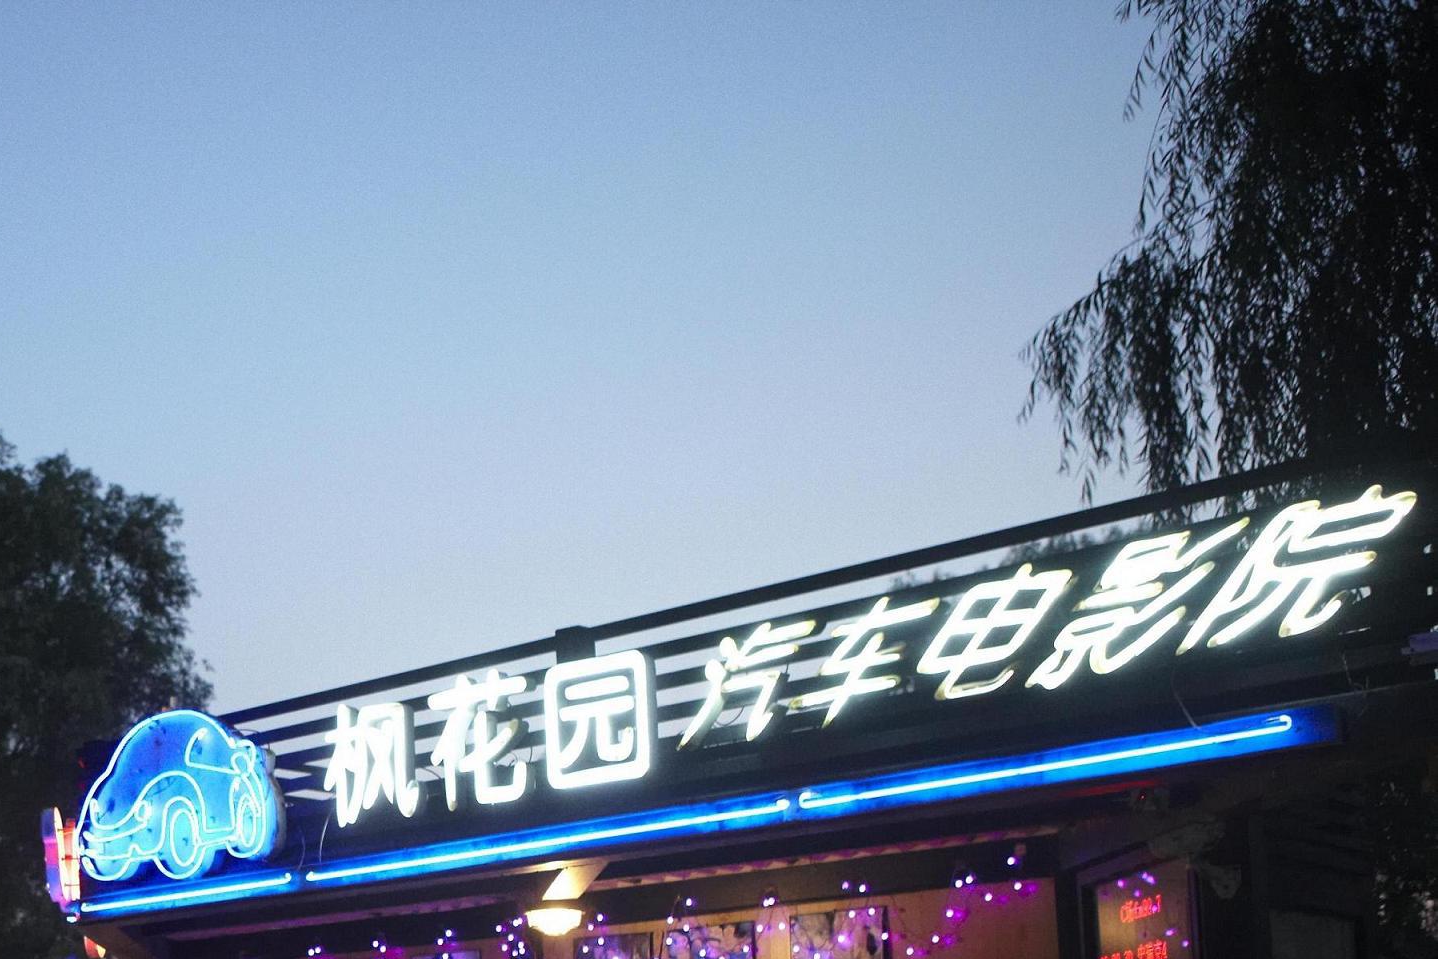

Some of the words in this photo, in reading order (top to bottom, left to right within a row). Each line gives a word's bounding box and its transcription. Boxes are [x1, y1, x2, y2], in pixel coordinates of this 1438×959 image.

[324, 650, 650, 828] 枫花园
[677, 485, 1418, 750] 汽车电影院
